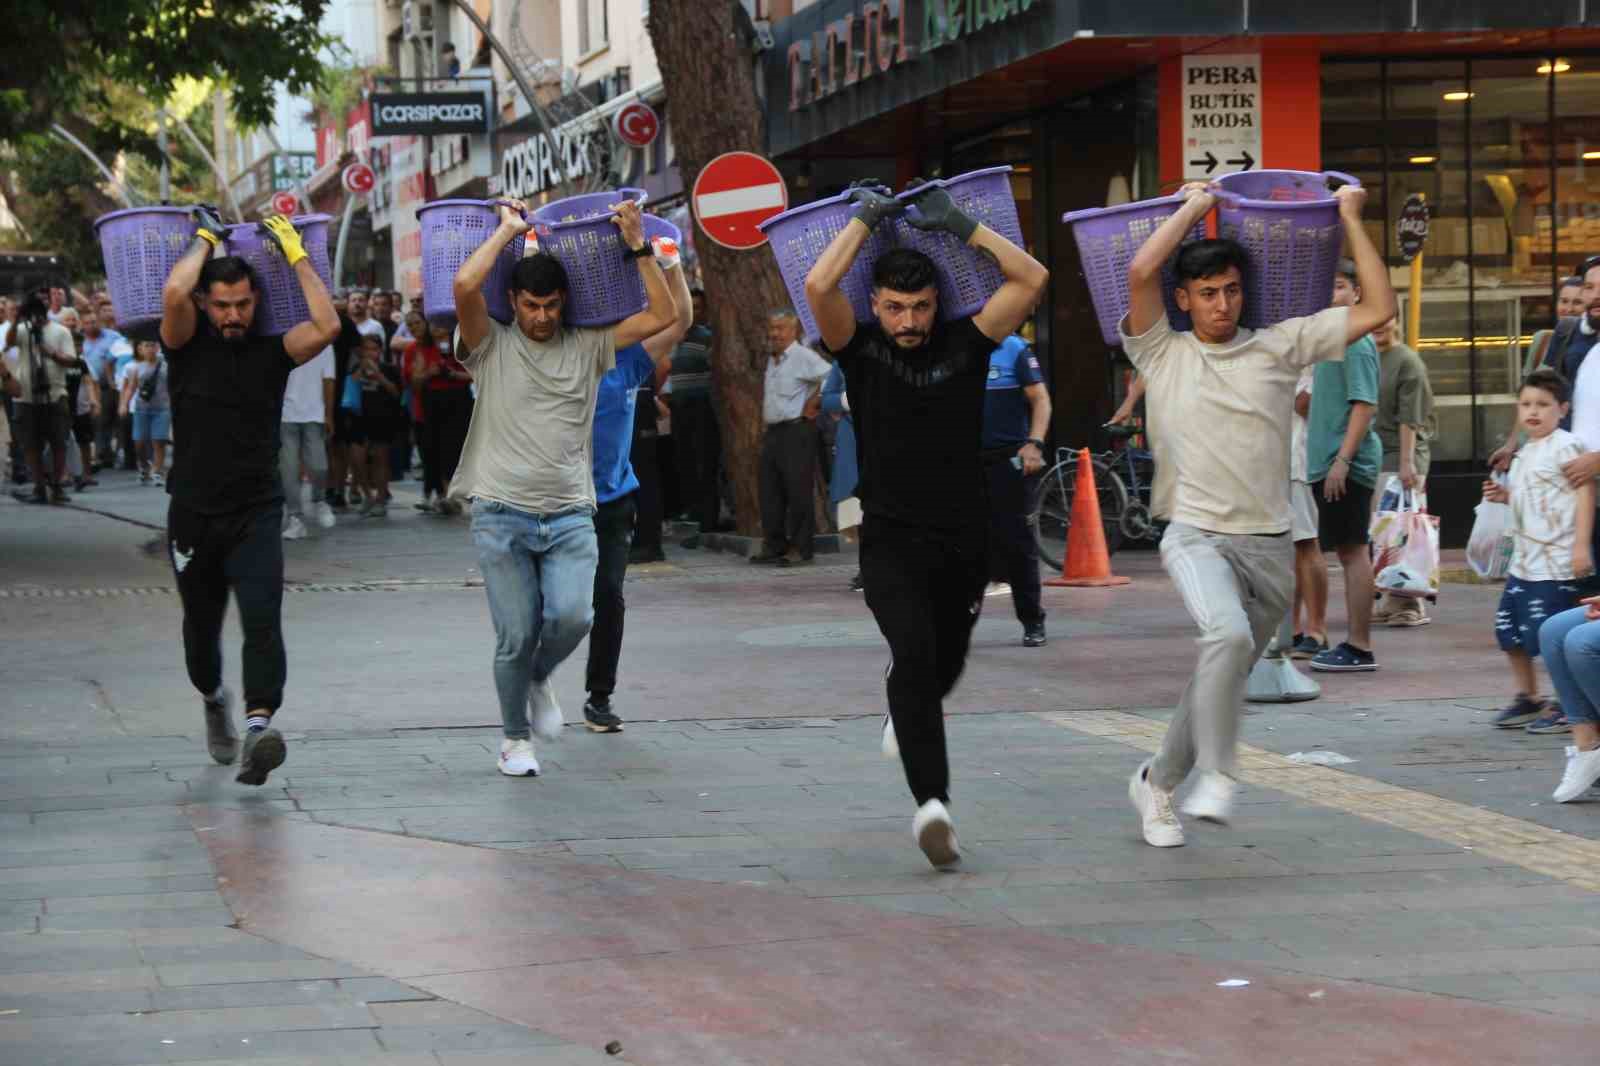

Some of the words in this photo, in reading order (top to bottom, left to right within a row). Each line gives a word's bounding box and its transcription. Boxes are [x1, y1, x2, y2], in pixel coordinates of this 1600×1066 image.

[1187, 66, 1257, 85] PERA
[1189, 88, 1255, 109] BUTİK
[1191, 113, 1253, 128] MODA
